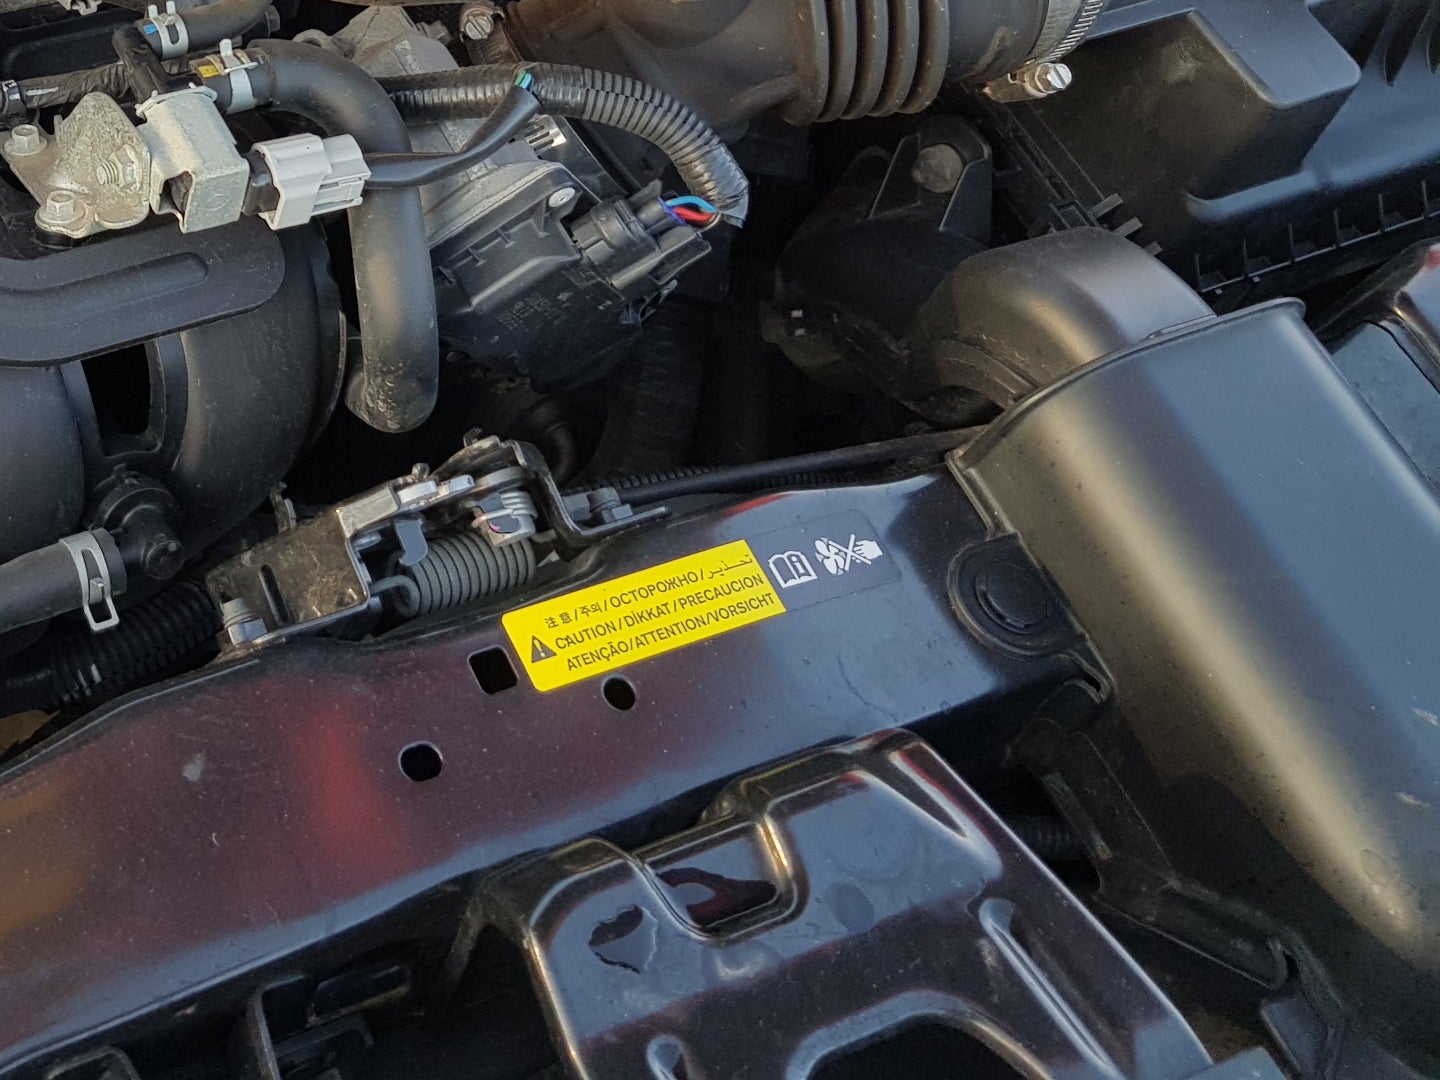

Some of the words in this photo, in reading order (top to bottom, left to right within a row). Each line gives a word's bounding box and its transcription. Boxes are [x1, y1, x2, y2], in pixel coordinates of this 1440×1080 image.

[555, 620, 617, 650] CAUTION
[678, 573, 765, 610] PRECAUCION
[579, 602, 603, 617] 주의
[707, 554, 753, 579] تحذير
